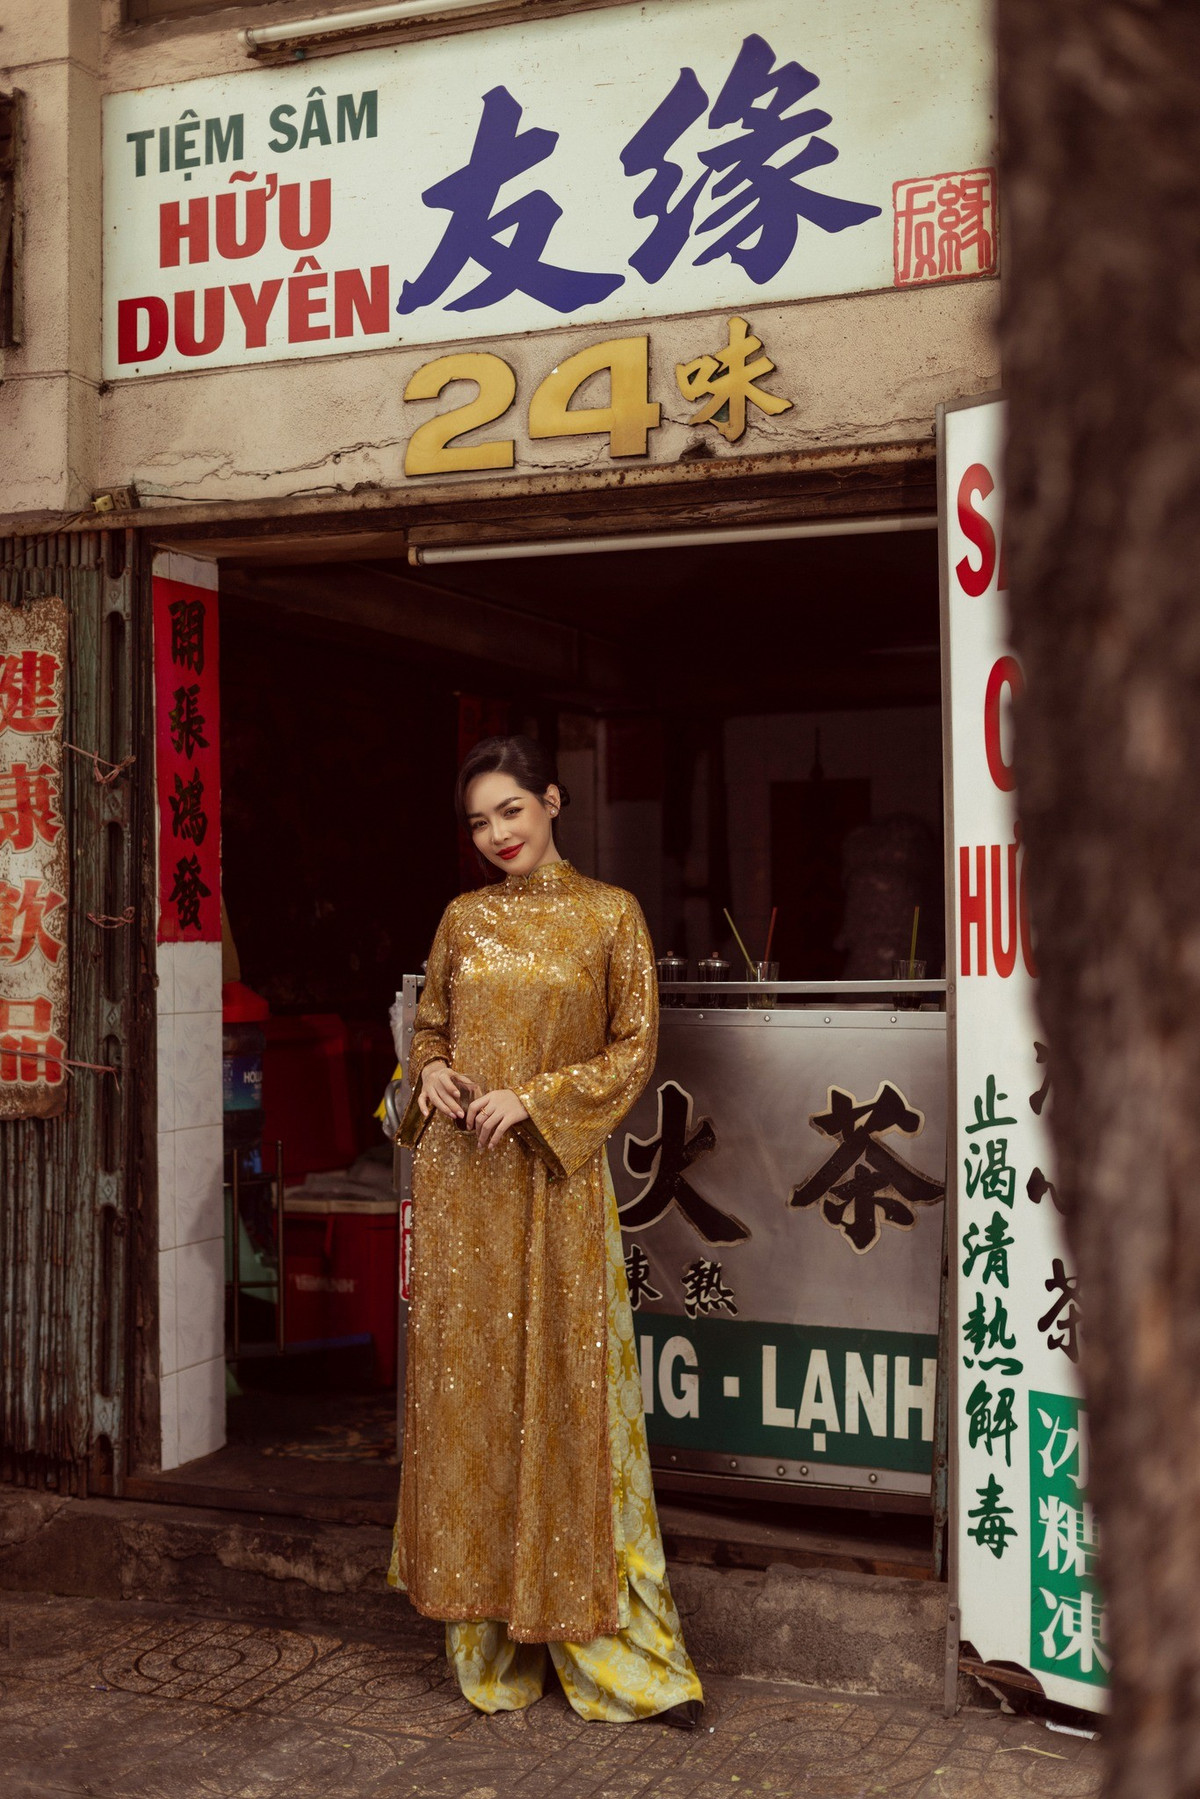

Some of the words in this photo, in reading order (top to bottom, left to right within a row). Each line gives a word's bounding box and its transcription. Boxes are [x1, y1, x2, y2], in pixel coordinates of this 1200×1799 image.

[127, 110, 245, 181] TIỆM
[268, 86, 379, 154] SÂM
[159, 170, 332, 269] HỮU
[118, 255, 390, 365] DUYÊN
[955, 463, 1007, 597] S
[168, 600, 212, 931] 開張鴻發
[959, 820, 1039, 979] HƯ
[762, 1345, 937, 1452] LẠNH
